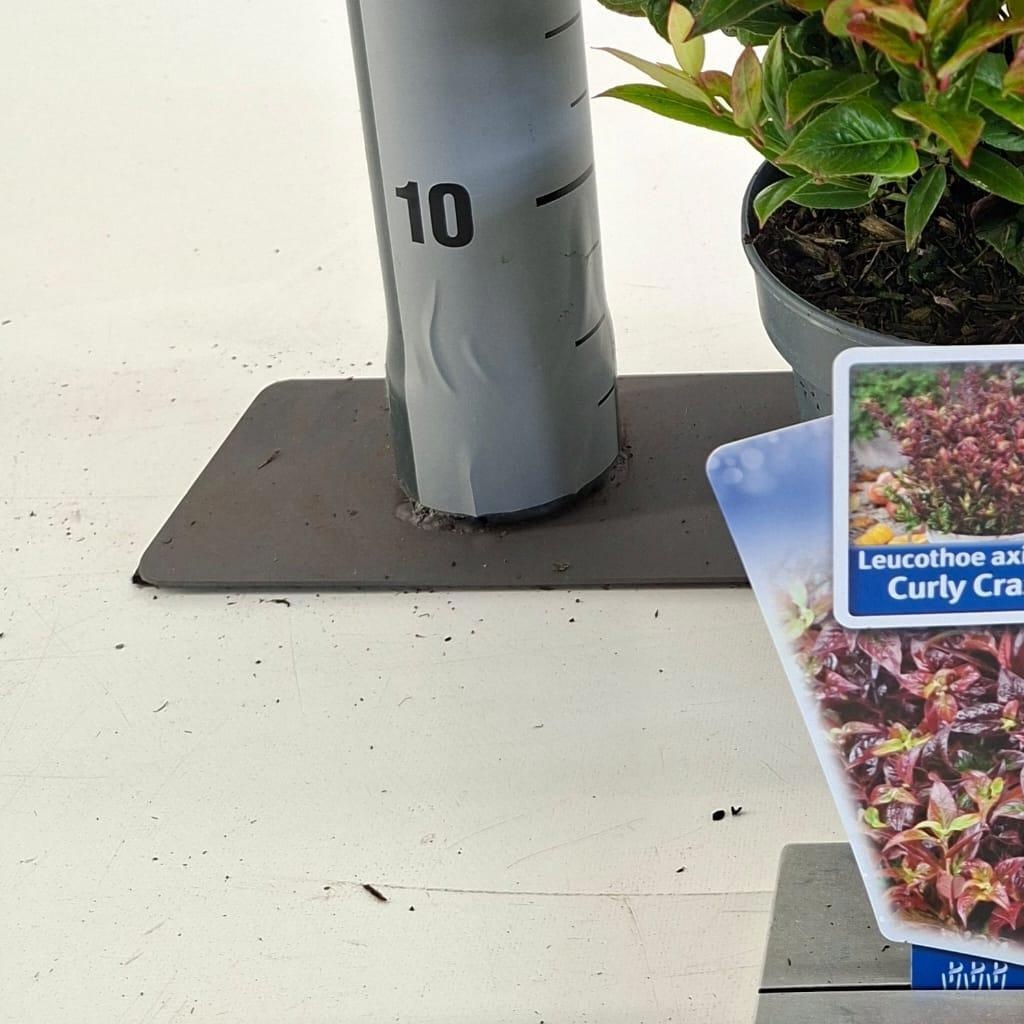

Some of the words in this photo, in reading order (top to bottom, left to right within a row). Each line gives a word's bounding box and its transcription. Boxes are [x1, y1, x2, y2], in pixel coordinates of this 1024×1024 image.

[395, 180, 475, 249] 10
[858, 548, 986, 570] Leucothoe
[888, 574, 966, 604] Curly
